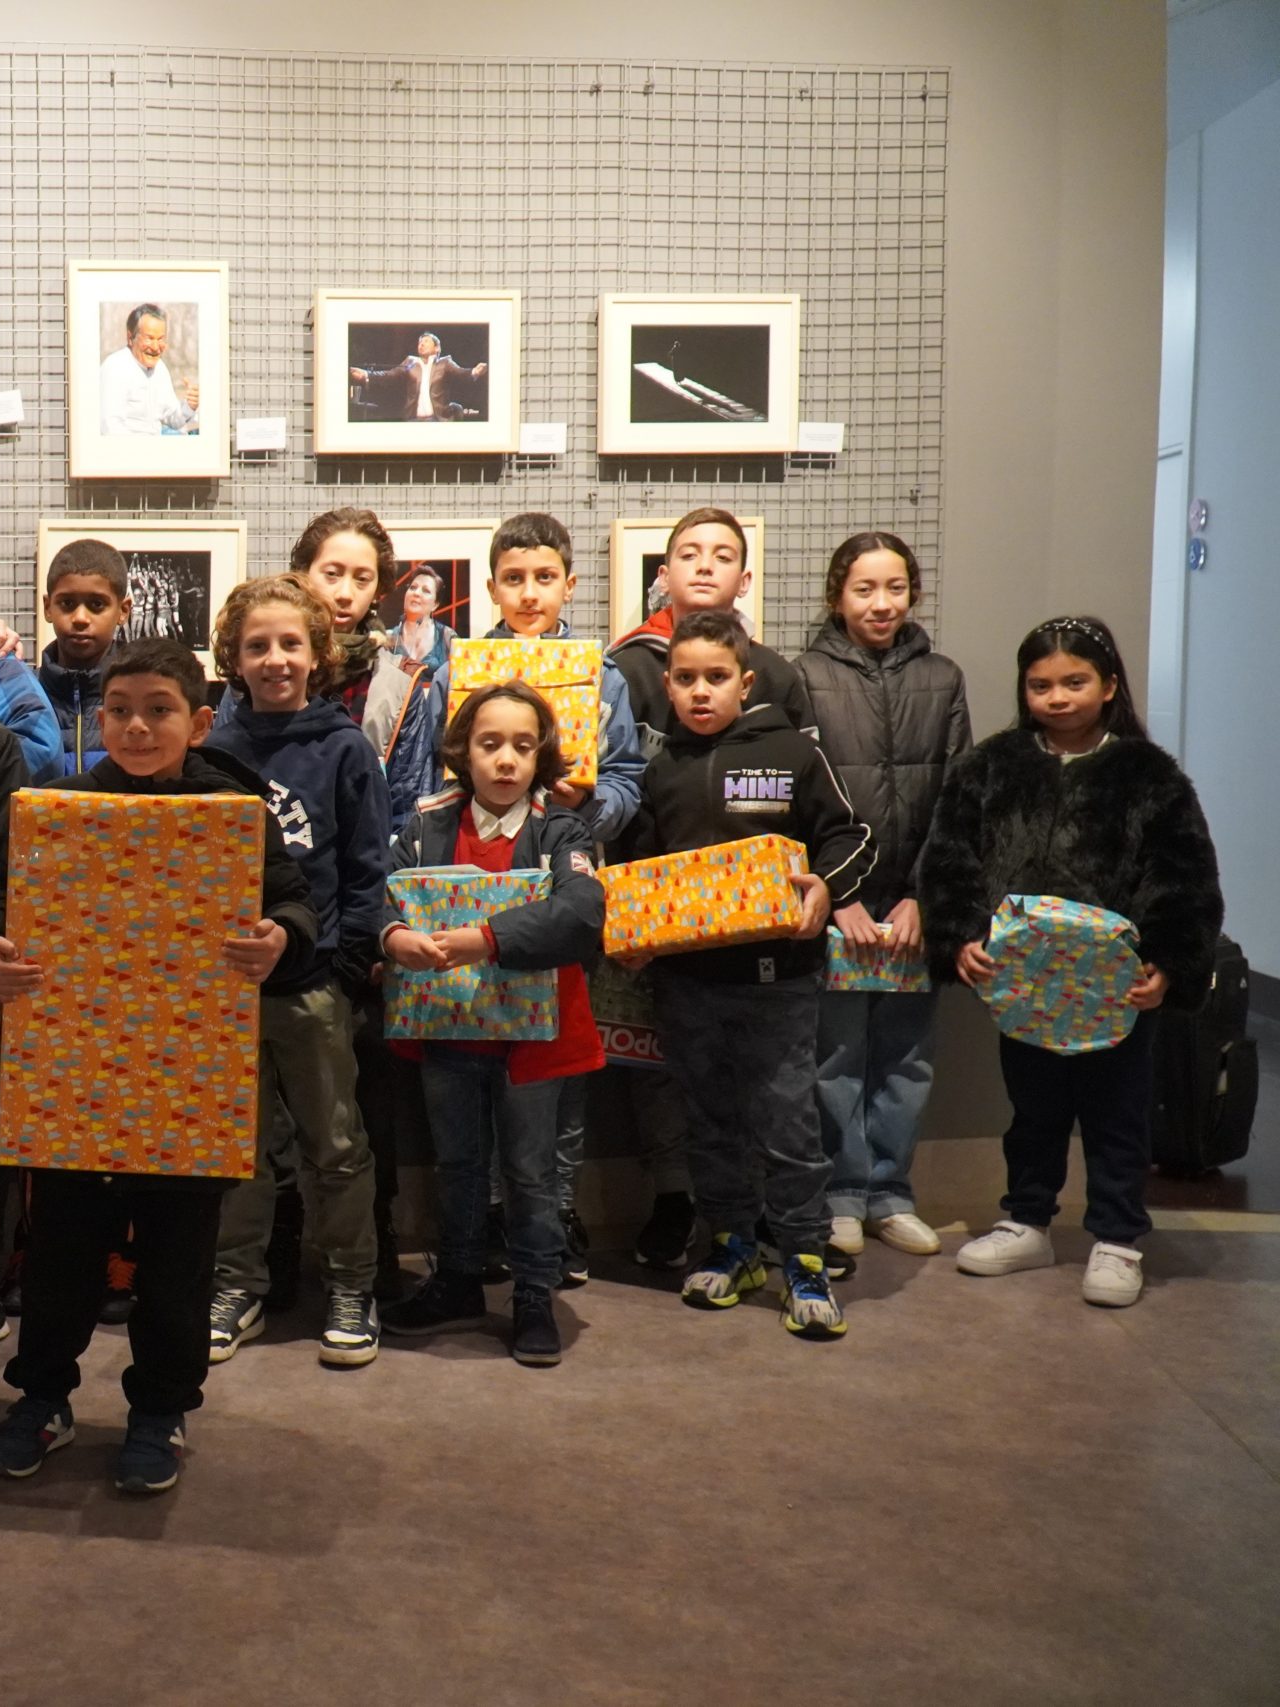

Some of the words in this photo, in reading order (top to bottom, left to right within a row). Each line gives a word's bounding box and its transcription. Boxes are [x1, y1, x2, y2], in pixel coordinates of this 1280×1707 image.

[741, 768, 763, 776] TIME
[765, 768, 778, 776] TO
[724, 776, 794, 800] MINE
